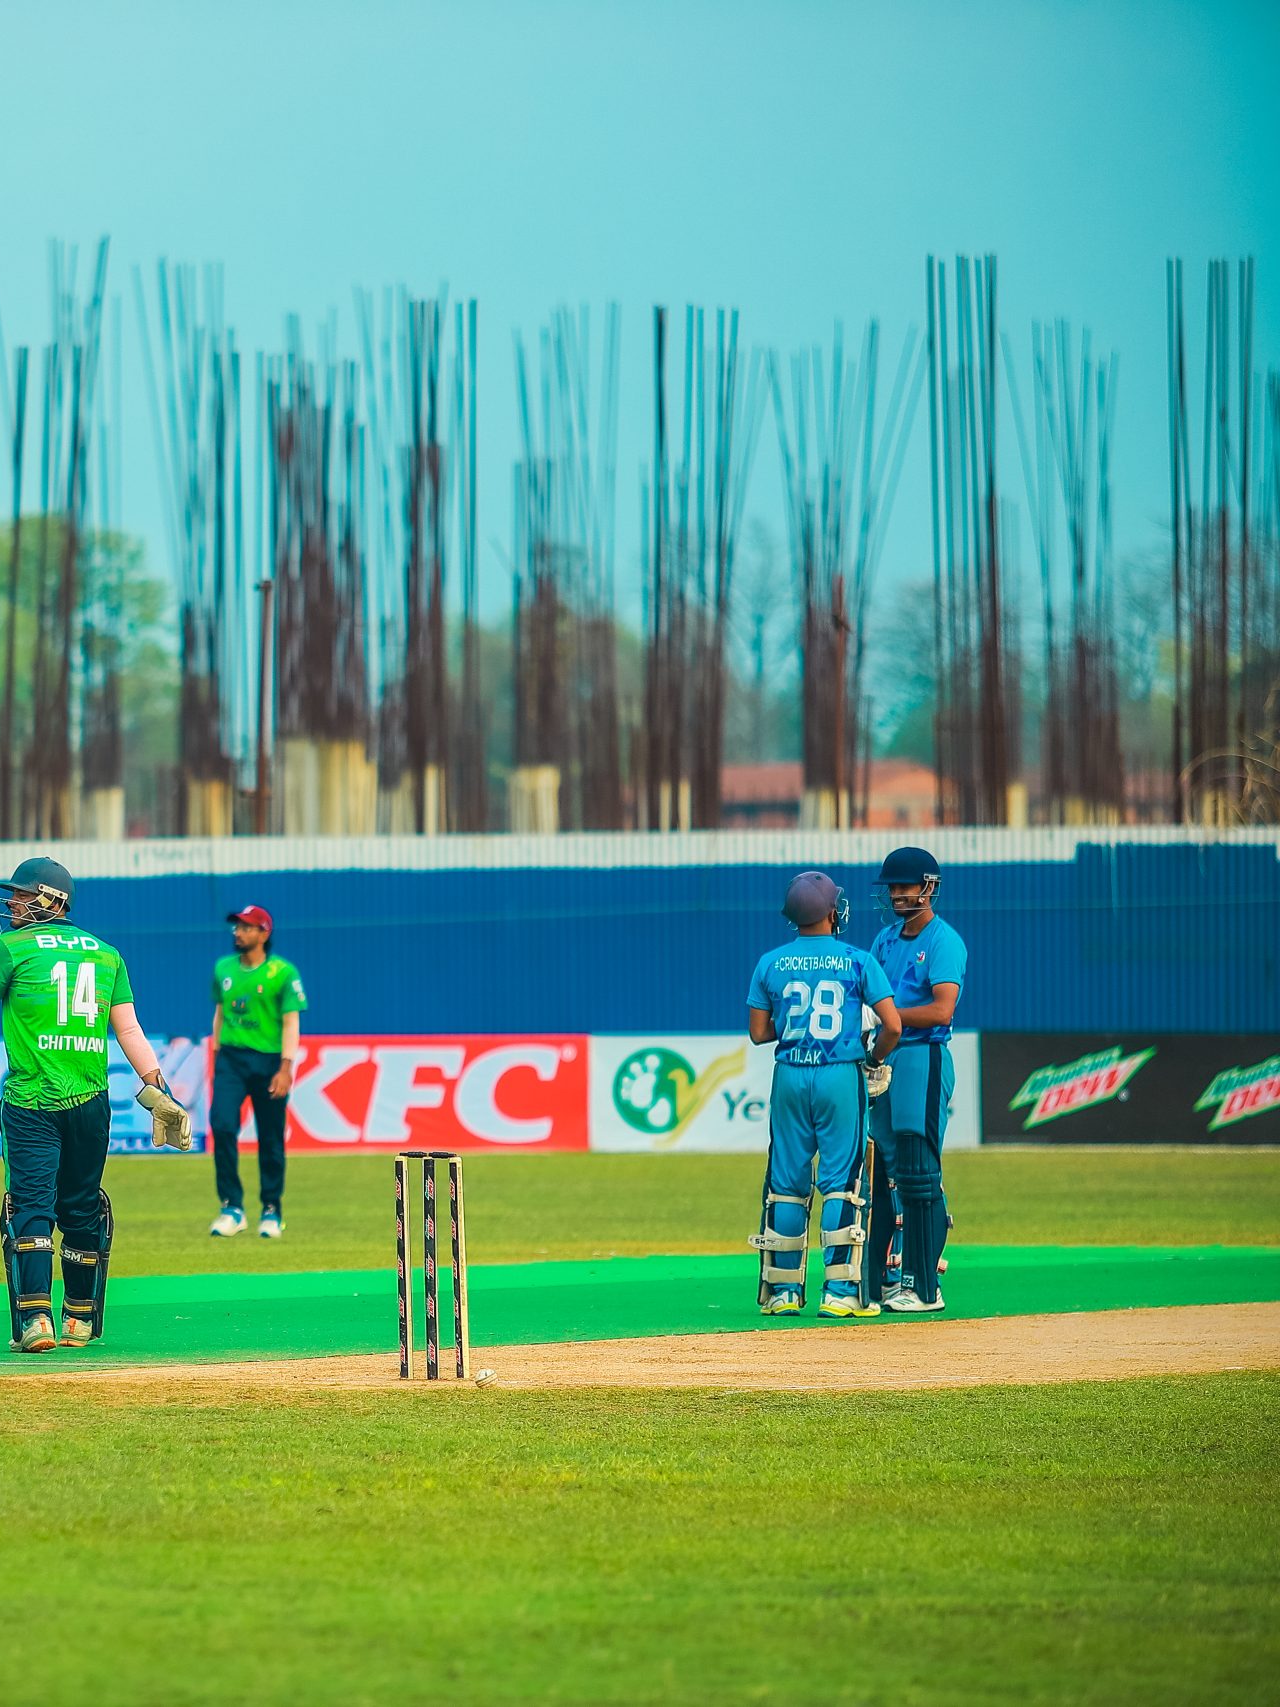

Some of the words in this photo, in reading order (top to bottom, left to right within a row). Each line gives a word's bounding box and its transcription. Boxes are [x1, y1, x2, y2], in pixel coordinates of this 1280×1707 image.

[35, 934, 99, 951] BYD
[50, 961, 99, 1028] 14
[782, 980, 845, 1041] 28
[38, 1034, 105, 1054] CHITWAN
[237, 1043, 562, 1144] KFC
